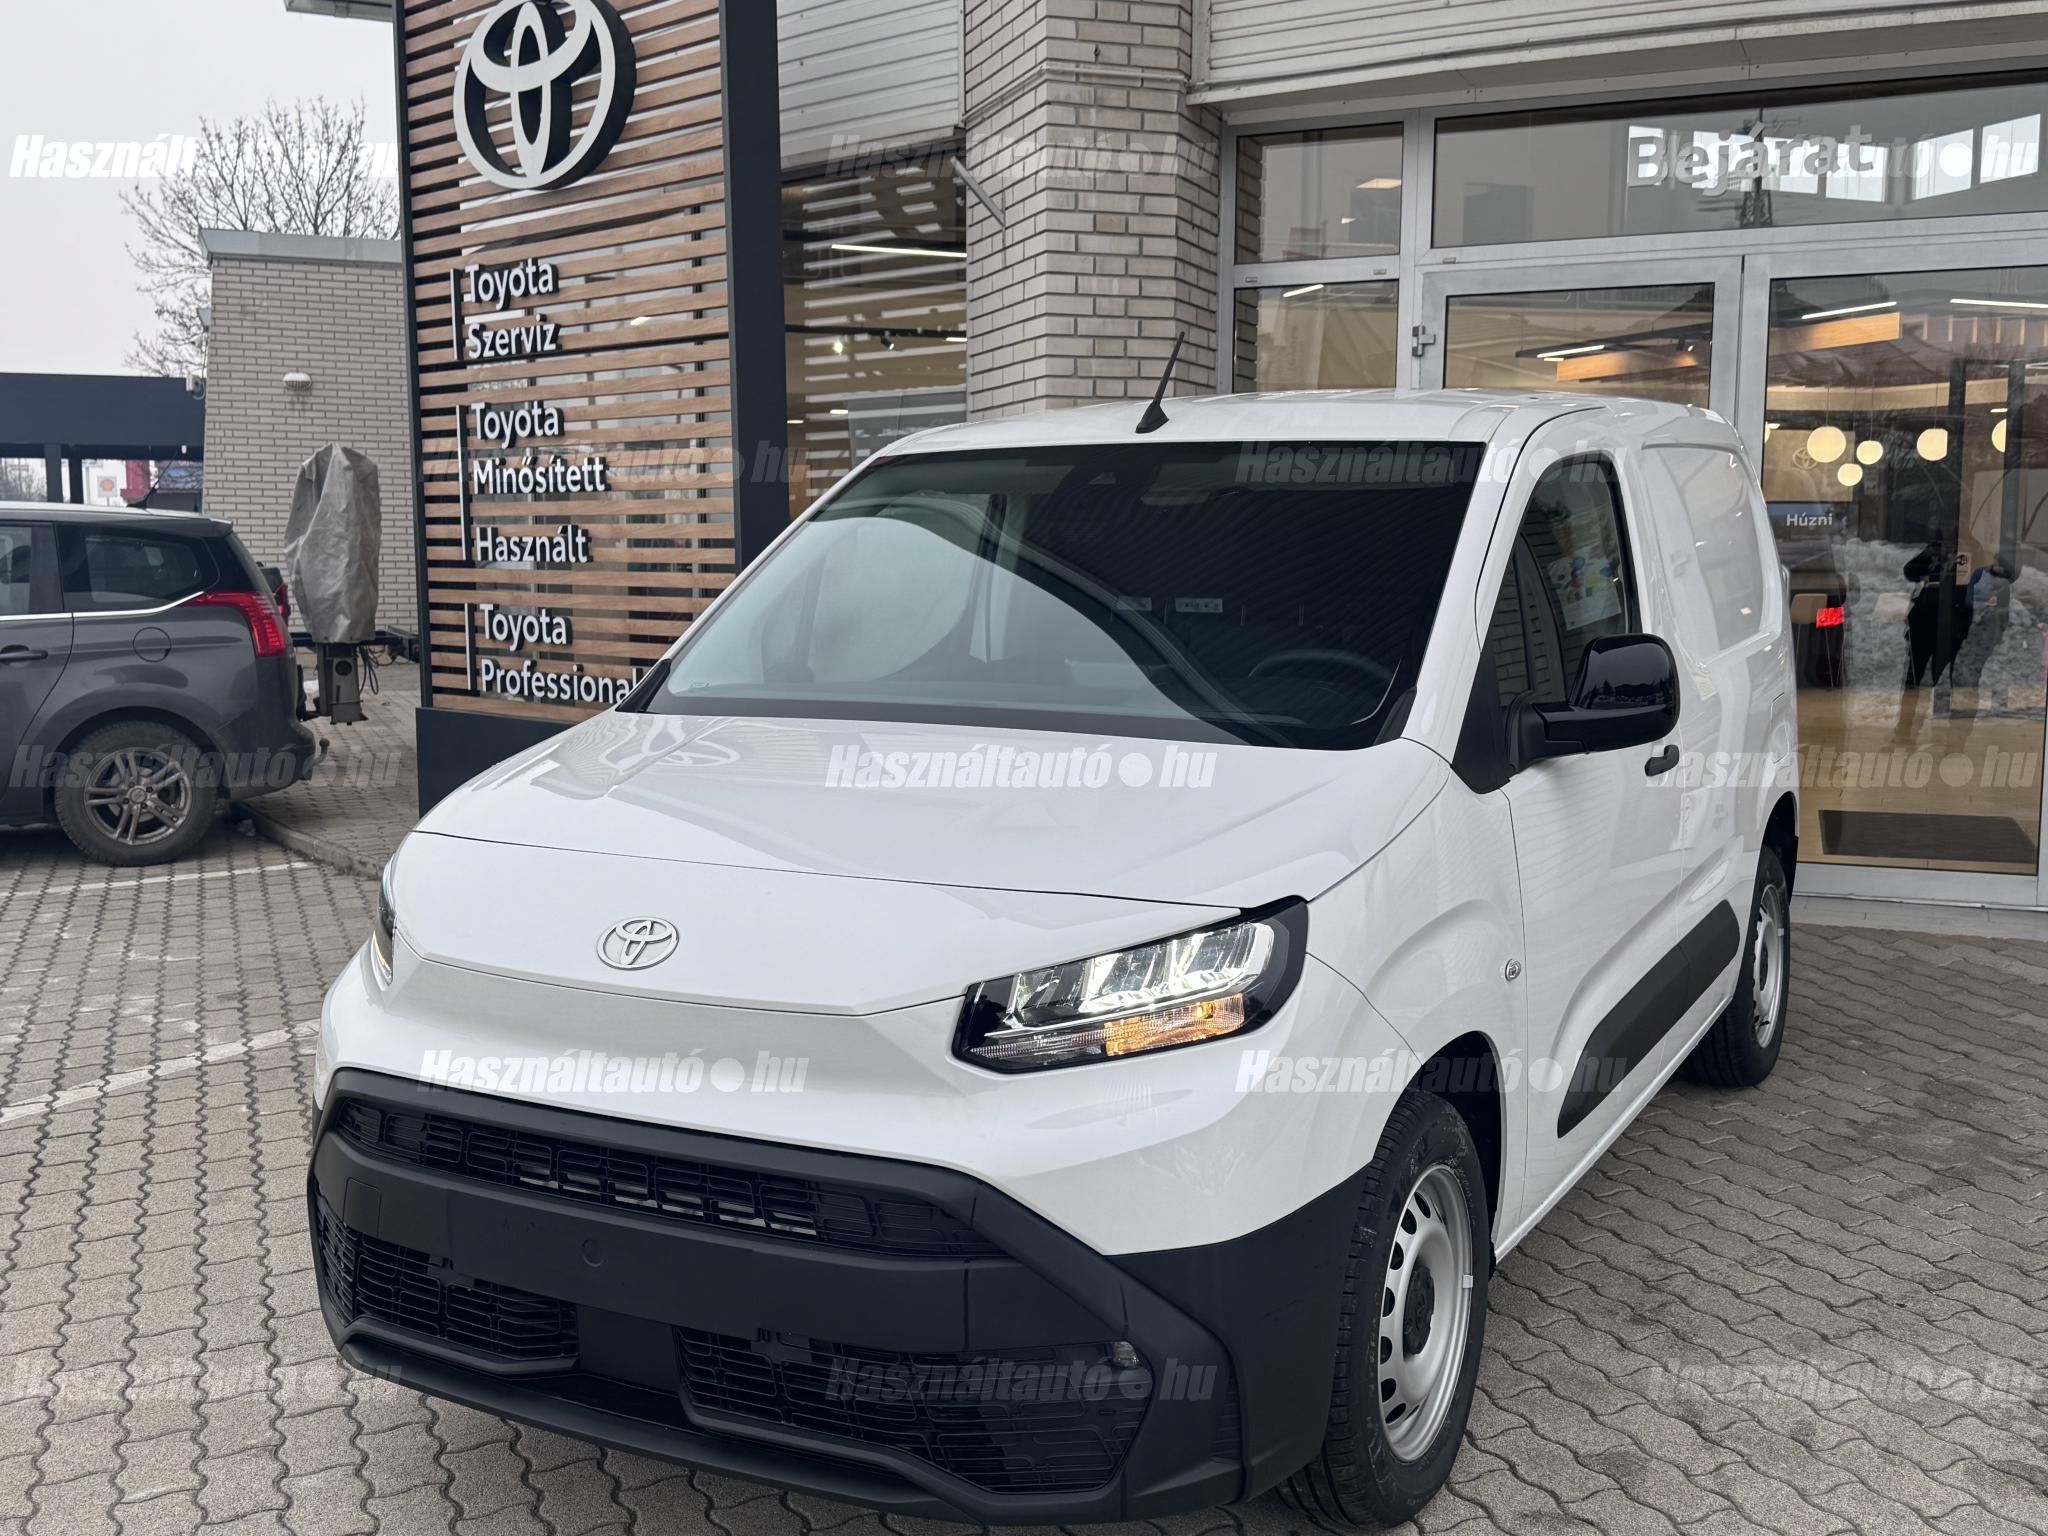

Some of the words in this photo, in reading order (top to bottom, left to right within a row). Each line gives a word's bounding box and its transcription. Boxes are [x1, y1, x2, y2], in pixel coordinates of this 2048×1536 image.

[1628, 121, 1874, 196] Bejárat
[465, 258, 553, 310] Toyota
[467, 314, 557, 359] Szerviz
[471, 400, 559, 449] Toyota
[473, 456, 605, 495] Minősített
[1786, 512, 1833, 526] Húzni
[476, 525, 587, 563] Használt
[480, 603, 567, 651] Toyota
